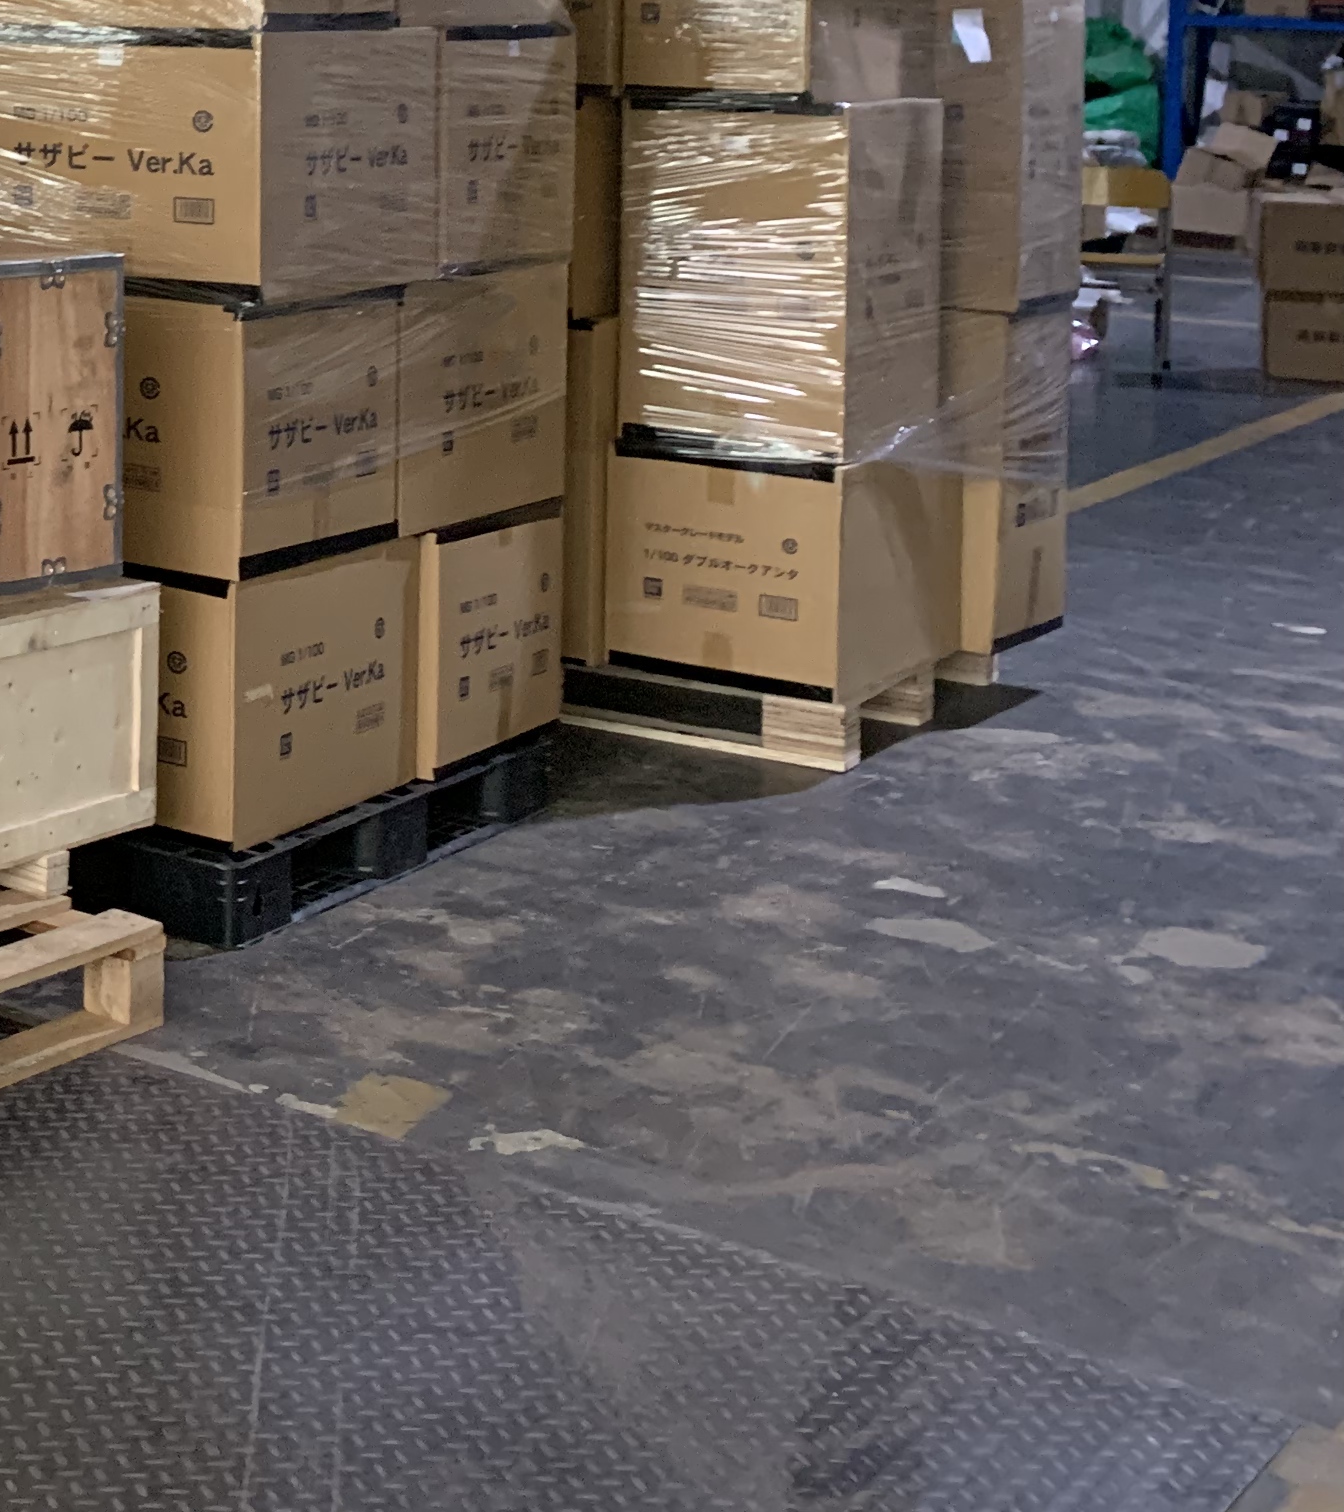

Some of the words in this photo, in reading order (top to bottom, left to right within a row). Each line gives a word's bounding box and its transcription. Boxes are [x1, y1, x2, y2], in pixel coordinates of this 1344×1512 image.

[13, 141, 116, 170] サザビー
[126, 148, 216, 177] Ver.Ka
[267, 418, 328, 450] サザビー
[333, 406, 379, 436] Ver.Ka
[459, 623, 509, 658] サザビー
[280, 676, 338, 715] サザビー
[343, 659, 386, 691] Ver.Ka
